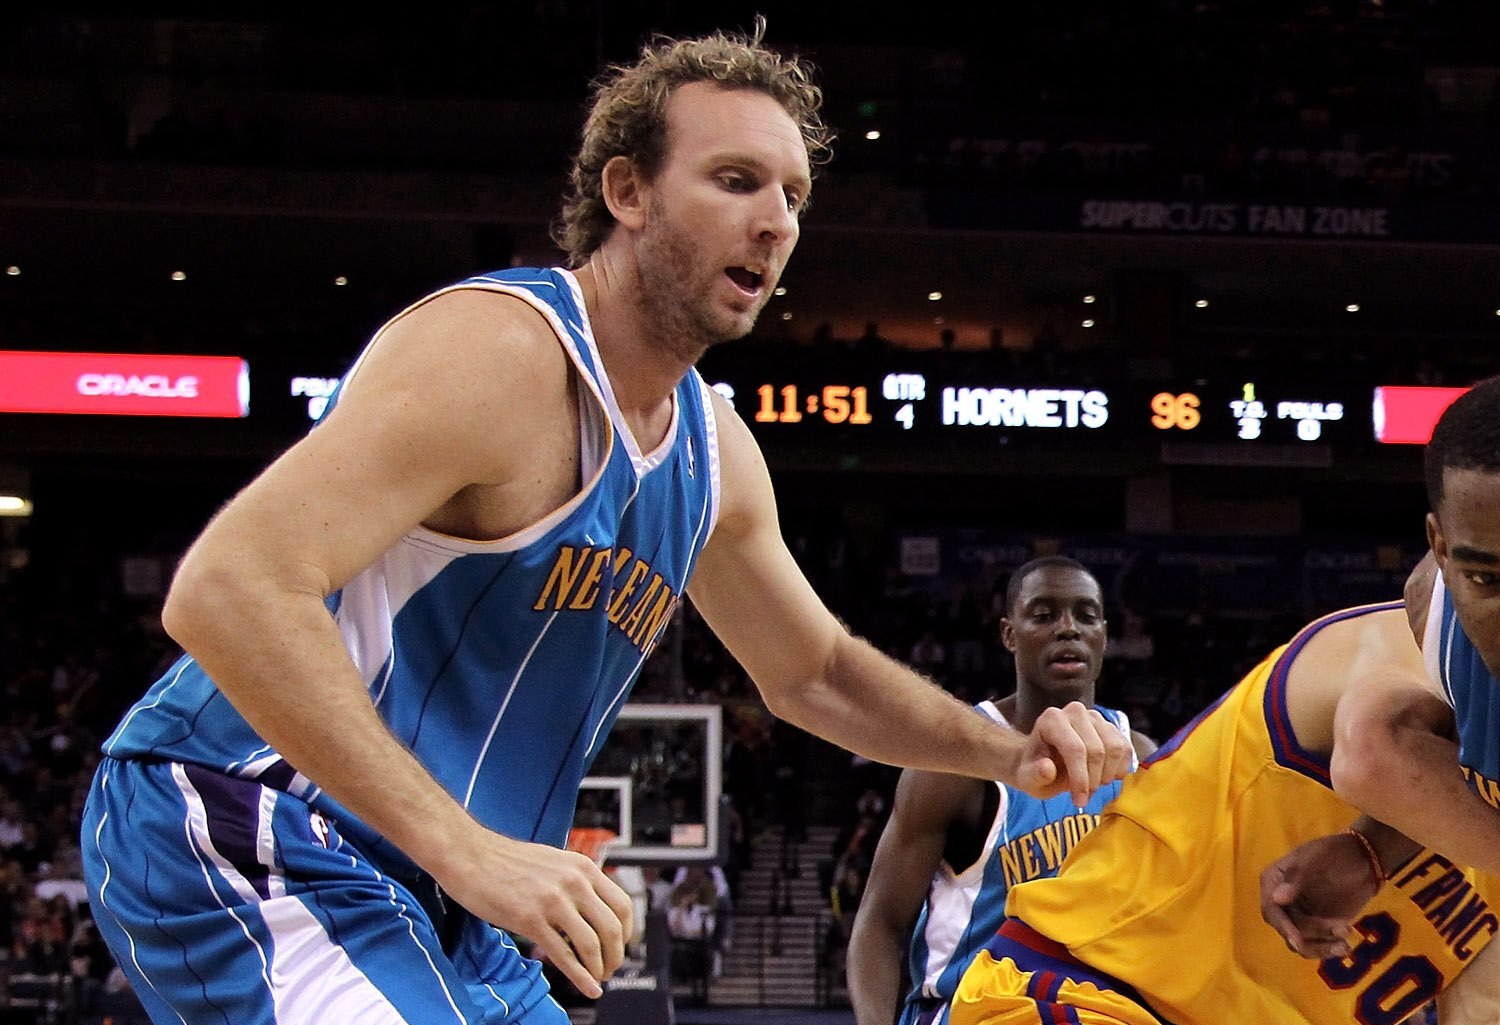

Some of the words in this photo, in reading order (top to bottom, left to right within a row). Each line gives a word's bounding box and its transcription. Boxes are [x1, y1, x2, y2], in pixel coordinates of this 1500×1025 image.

[1079, 200, 1238, 231] SUPERCUTS
[1248, 205, 1303, 234] FAN
[1311, 206, 1391, 236] ZONE
[76, 373, 200, 399] ORACLE
[755, 384, 872, 424] 11:51
[895, 404, 915, 430] 4
[942, 387, 1109, 429] HORNETS
[1150, 392, 1201, 431] 96
[1297, 419, 1321, 441] 0
